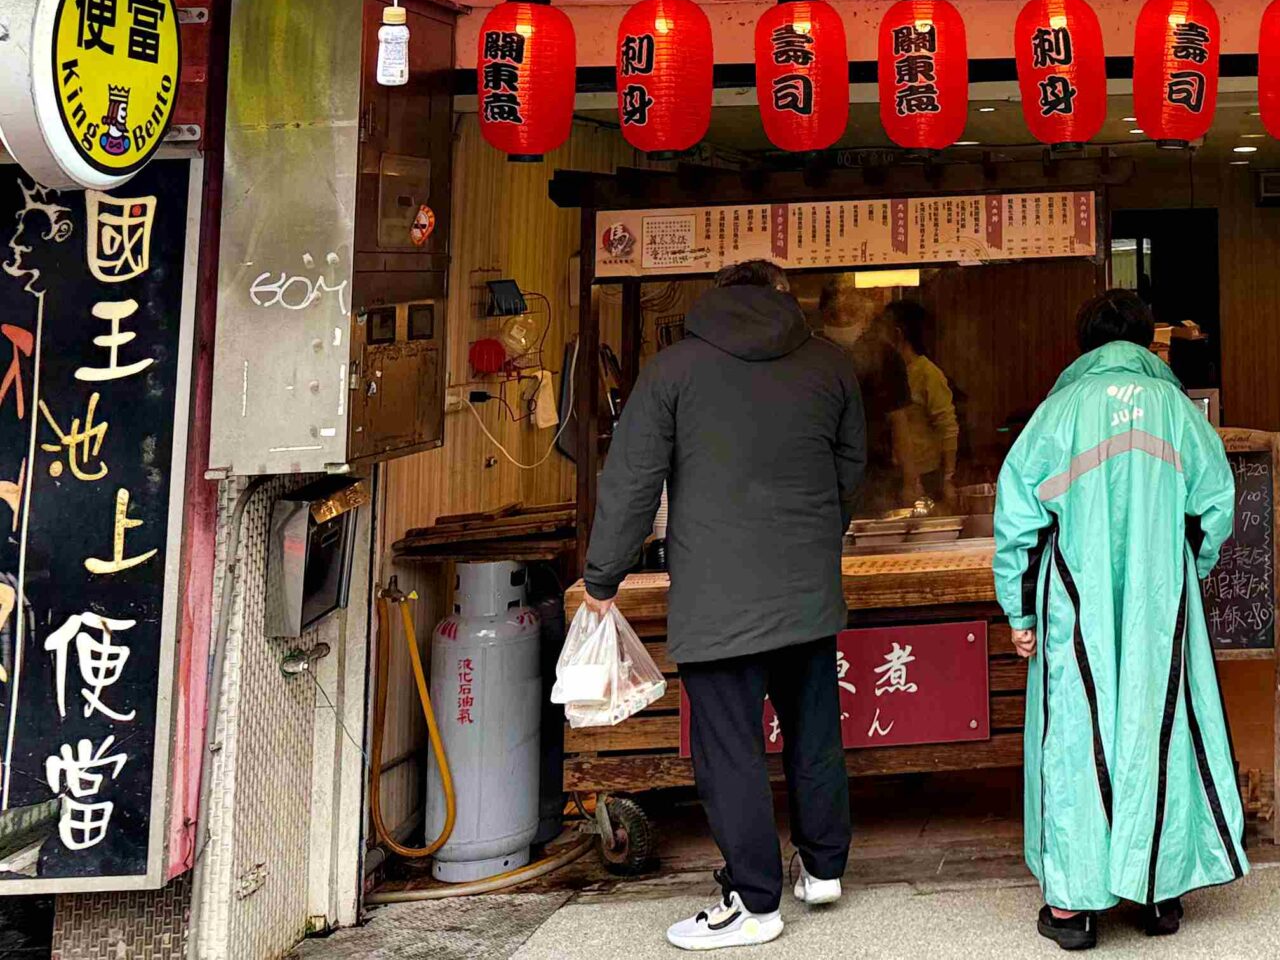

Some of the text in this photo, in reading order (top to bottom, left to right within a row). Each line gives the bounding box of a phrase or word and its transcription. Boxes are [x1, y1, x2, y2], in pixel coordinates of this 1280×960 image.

[61, 57, 173, 153] King Bento
[483, 29, 524, 125] 關東煮
[620, 34, 655, 127] 刺身
[770, 24, 814, 117] 壽司
[892, 24, 939, 115] 關東煮
[1031, 26, 1076, 117] 刺身
[1168, 22, 1209, 113] 壽司
[457, 658, 475, 726] 液化石油氣
